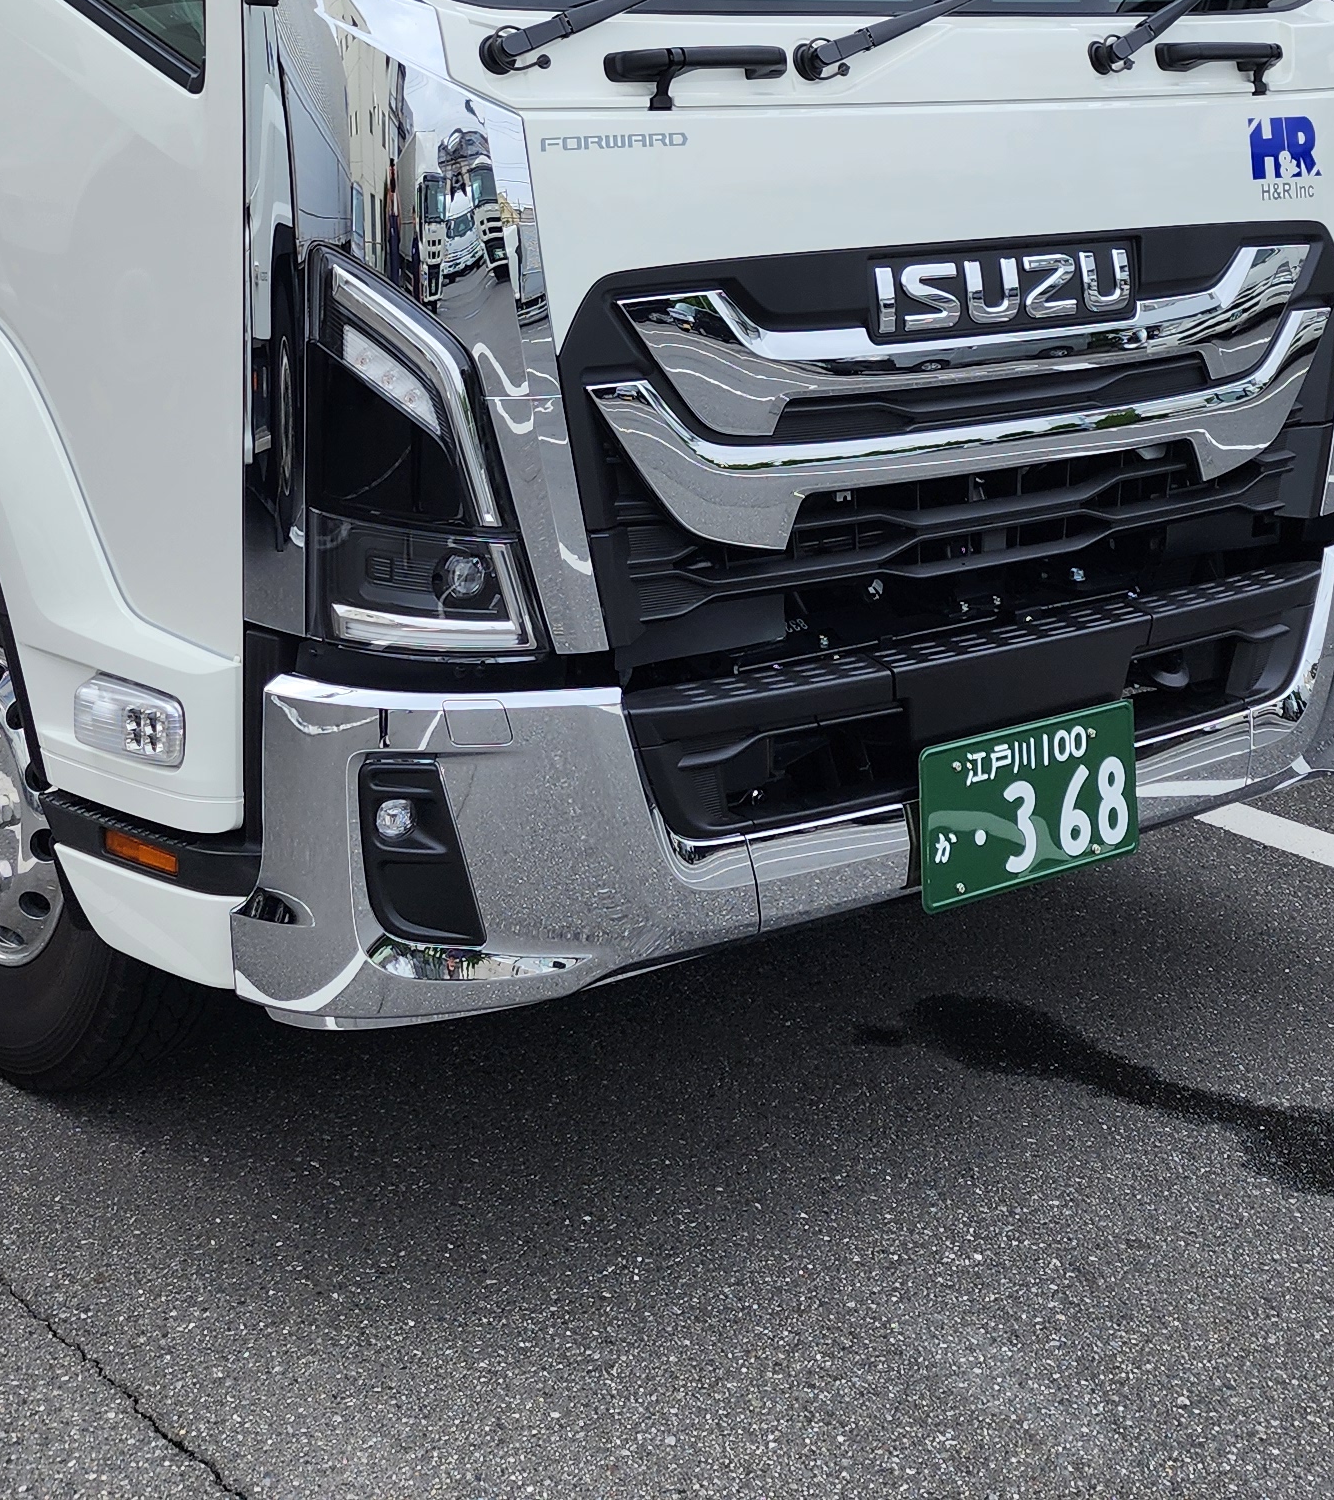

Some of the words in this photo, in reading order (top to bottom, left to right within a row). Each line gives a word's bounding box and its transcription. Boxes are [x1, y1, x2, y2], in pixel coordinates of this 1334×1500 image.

[540, 132, 688, 152] FORWARD
[1261, 182, 1292, 201] H&R
[1295, 181, 1315, 199] Inc
[874, 249, 1130, 334] ISUZU
